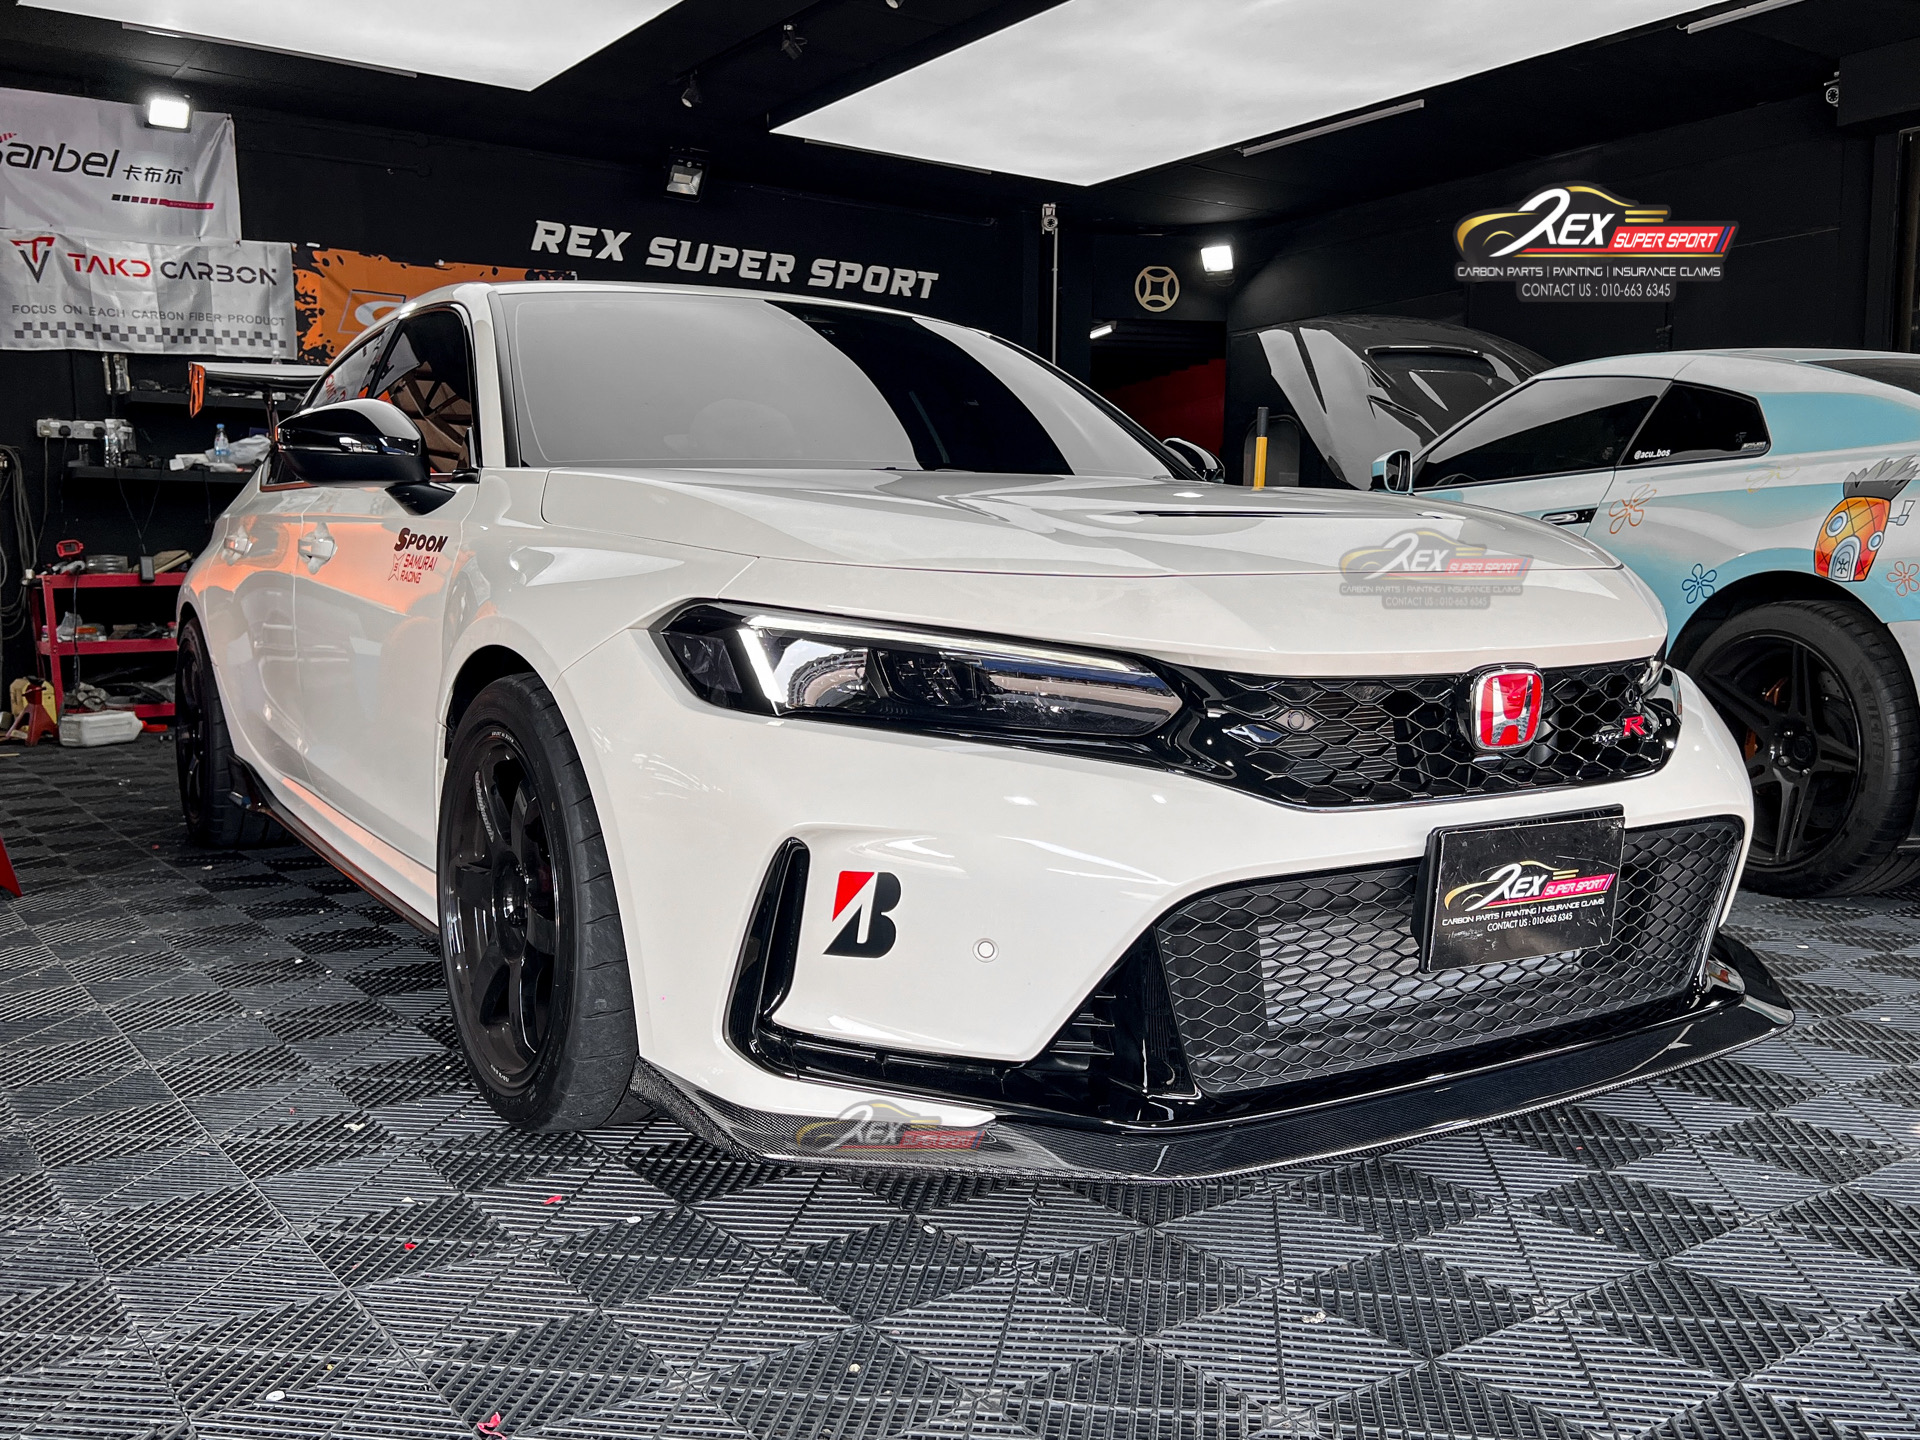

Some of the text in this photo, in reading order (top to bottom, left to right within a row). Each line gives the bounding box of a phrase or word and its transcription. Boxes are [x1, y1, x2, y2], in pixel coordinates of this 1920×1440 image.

[0, 142, 120, 178] arbel
[122, 164, 184, 185] 卡布尔
[530, 220, 939, 299] REX SUPER SPORT
[160, 260, 278, 286] CARBON
[12, 304, 286, 327] FOCUS ON EACH CARBON FIBER PRODUCT
[1634, 449, 1671, 459] @acu_bos
[394, 527, 448, 552] SPOON
[403, 553, 438, 571] SAMURAI
[400, 570, 422, 584] RACING
[1623, 715, 1647, 738] R
[1464, 863, 1606, 912] REX SUPER SPORT
[1442, 898, 1605, 926] CARBON PARTS PAINTING INSURANCE CLAIMS
[1487, 912, 1573, 932] CONTACT US 010-663 6345
